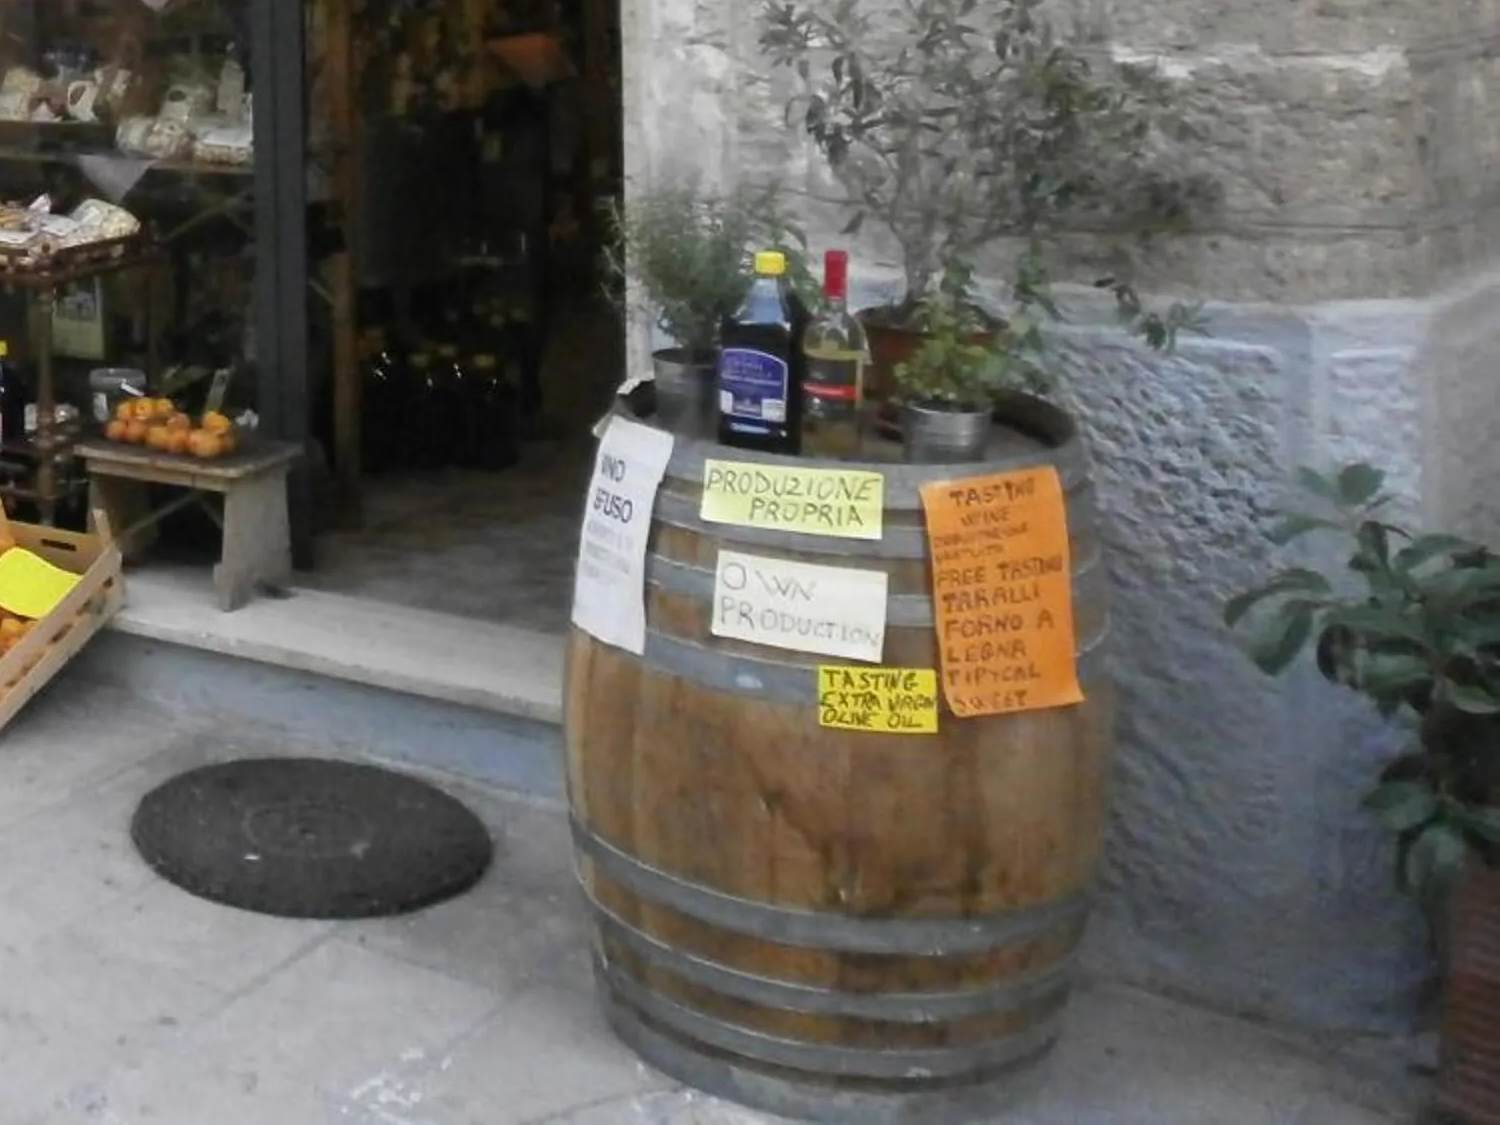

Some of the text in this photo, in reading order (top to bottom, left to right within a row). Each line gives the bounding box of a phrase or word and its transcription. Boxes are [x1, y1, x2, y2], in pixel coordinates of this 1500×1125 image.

[705, 469, 881, 502] PRODUZIONE
[948, 477, 1035, 507] TASTING
[748, 500, 866, 528] PROPRIA
[941, 582, 1040, 613] TARALLI
[718, 597, 882, 649] PRODUCTION
[943, 607, 1055, 640] FORNO A
[824, 671, 918, 692] TASTING
[820, 689, 881, 710] EXTRA
[821, 710, 922, 730] OLIVE OIL
